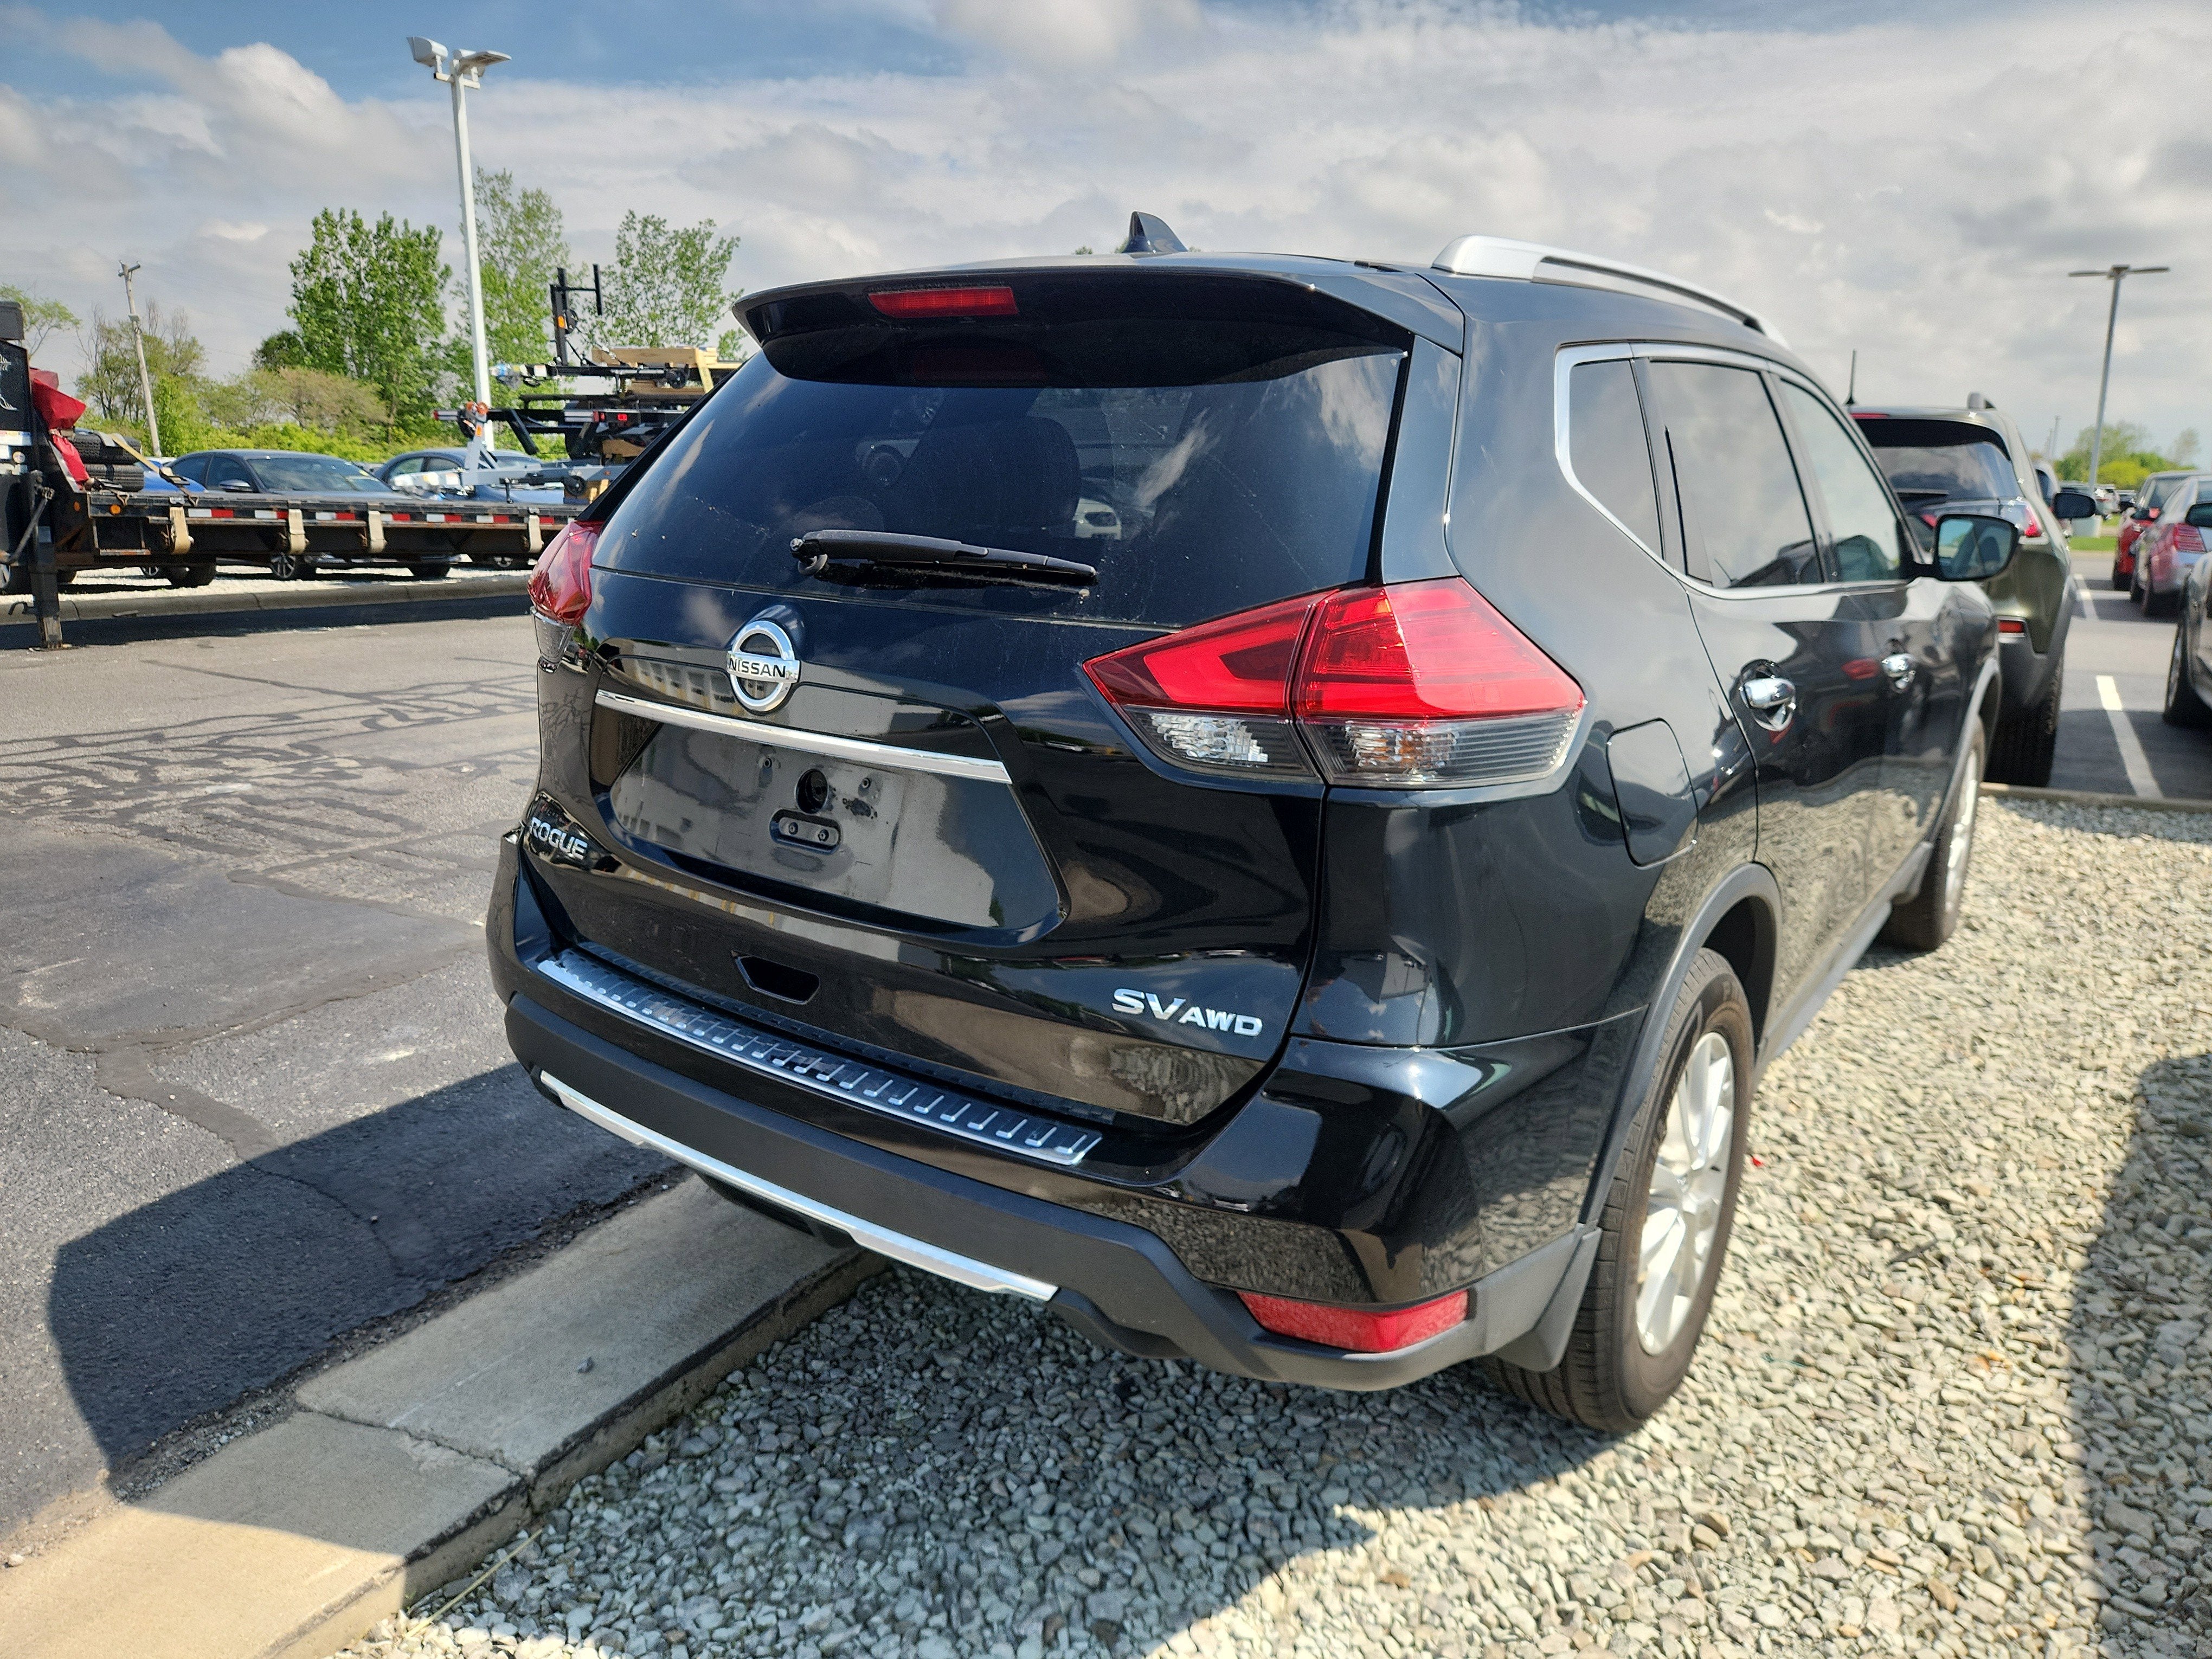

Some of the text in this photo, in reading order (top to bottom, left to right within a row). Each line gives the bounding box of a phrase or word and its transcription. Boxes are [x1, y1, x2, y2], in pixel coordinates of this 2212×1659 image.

[728, 657, 786, 678] NISSAN
[529, 817, 588, 860] ROGUE
[1112, 988, 1263, 1036] SV AWD
